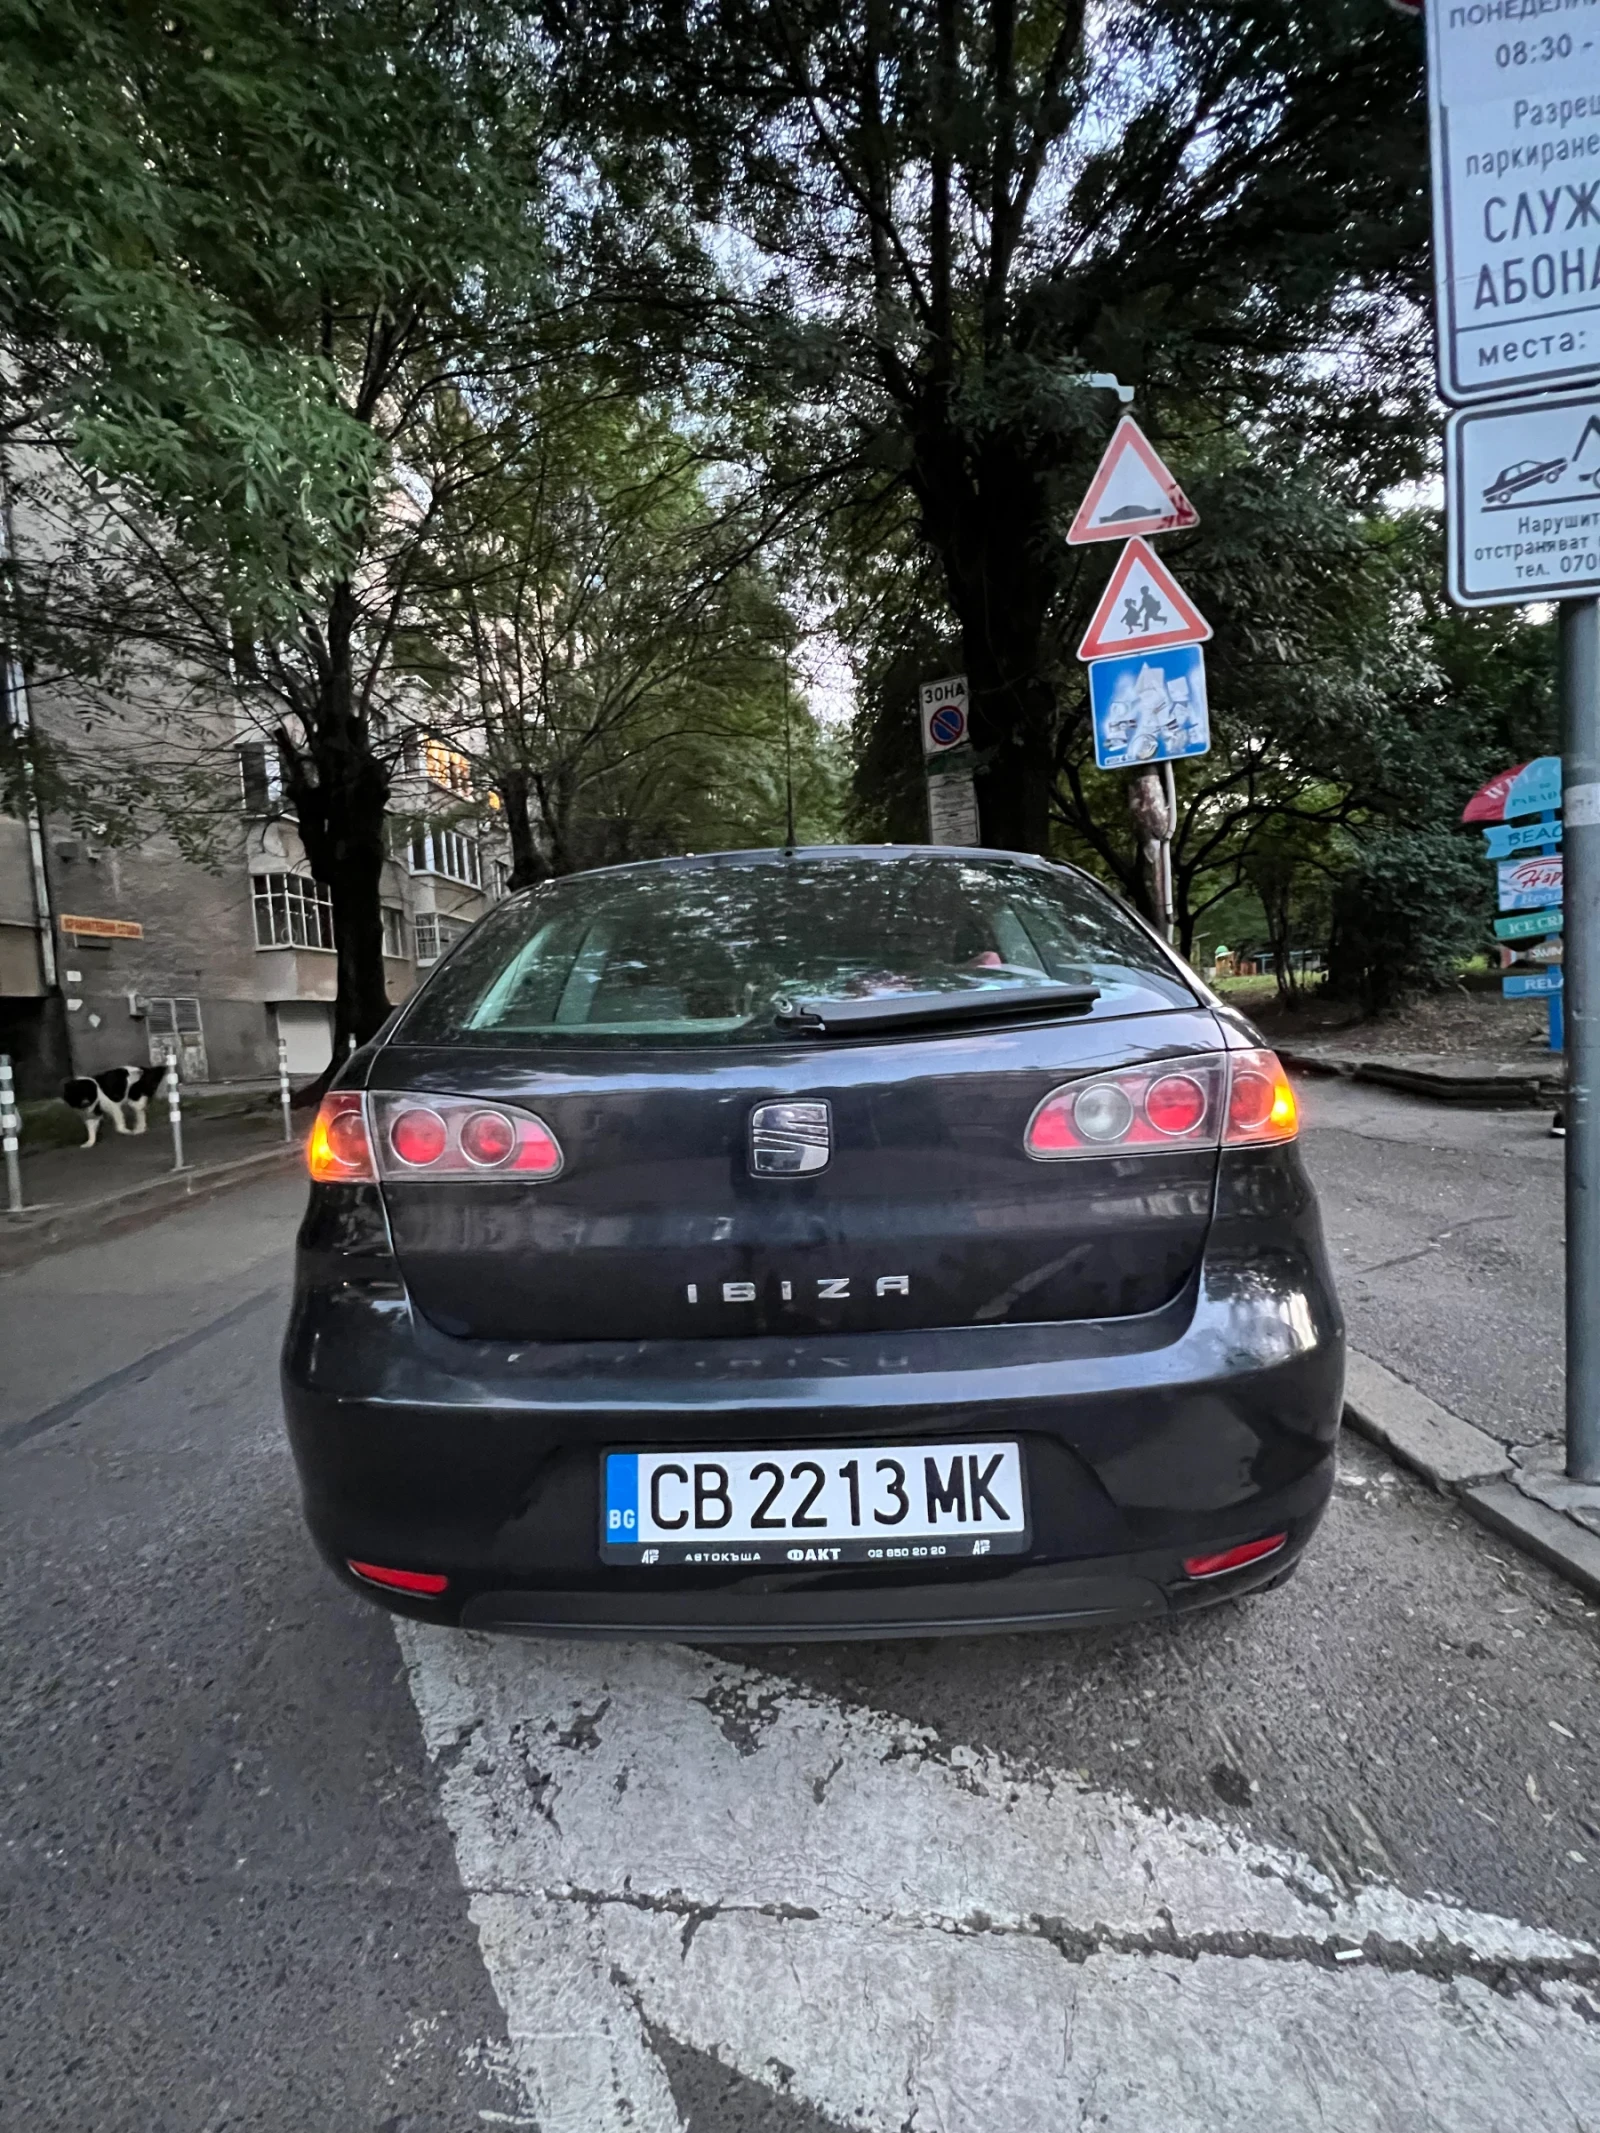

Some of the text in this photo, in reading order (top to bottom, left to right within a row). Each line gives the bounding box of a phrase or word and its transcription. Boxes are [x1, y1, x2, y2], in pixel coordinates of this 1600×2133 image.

[1495, 33, 1572, 68] 08:30
[1484, 179, 1600, 242] СЛУЖ
[1478, 330, 1587, 367] места:
[1474, 536, 1589, 561] отстраняват
[1515, 552, 1600, 578] тел. 070
[924, 682, 965, 704] ЗОНА
[1517, 868, 1563, 889] Hap
[1509, 919, 1534, 934] ICE
[687, 1275, 910, 1303] IBIZA
[650, 1453, 1011, 1530] CB 2213 MK
[609, 1509, 636, 1530] BG
[787, 1548, 842, 1561] ФАКТ
[867, 1548, 883, 1558] 02
[912, 1546, 928, 1556] 20
[930, 1545, 946, 1555] 20
